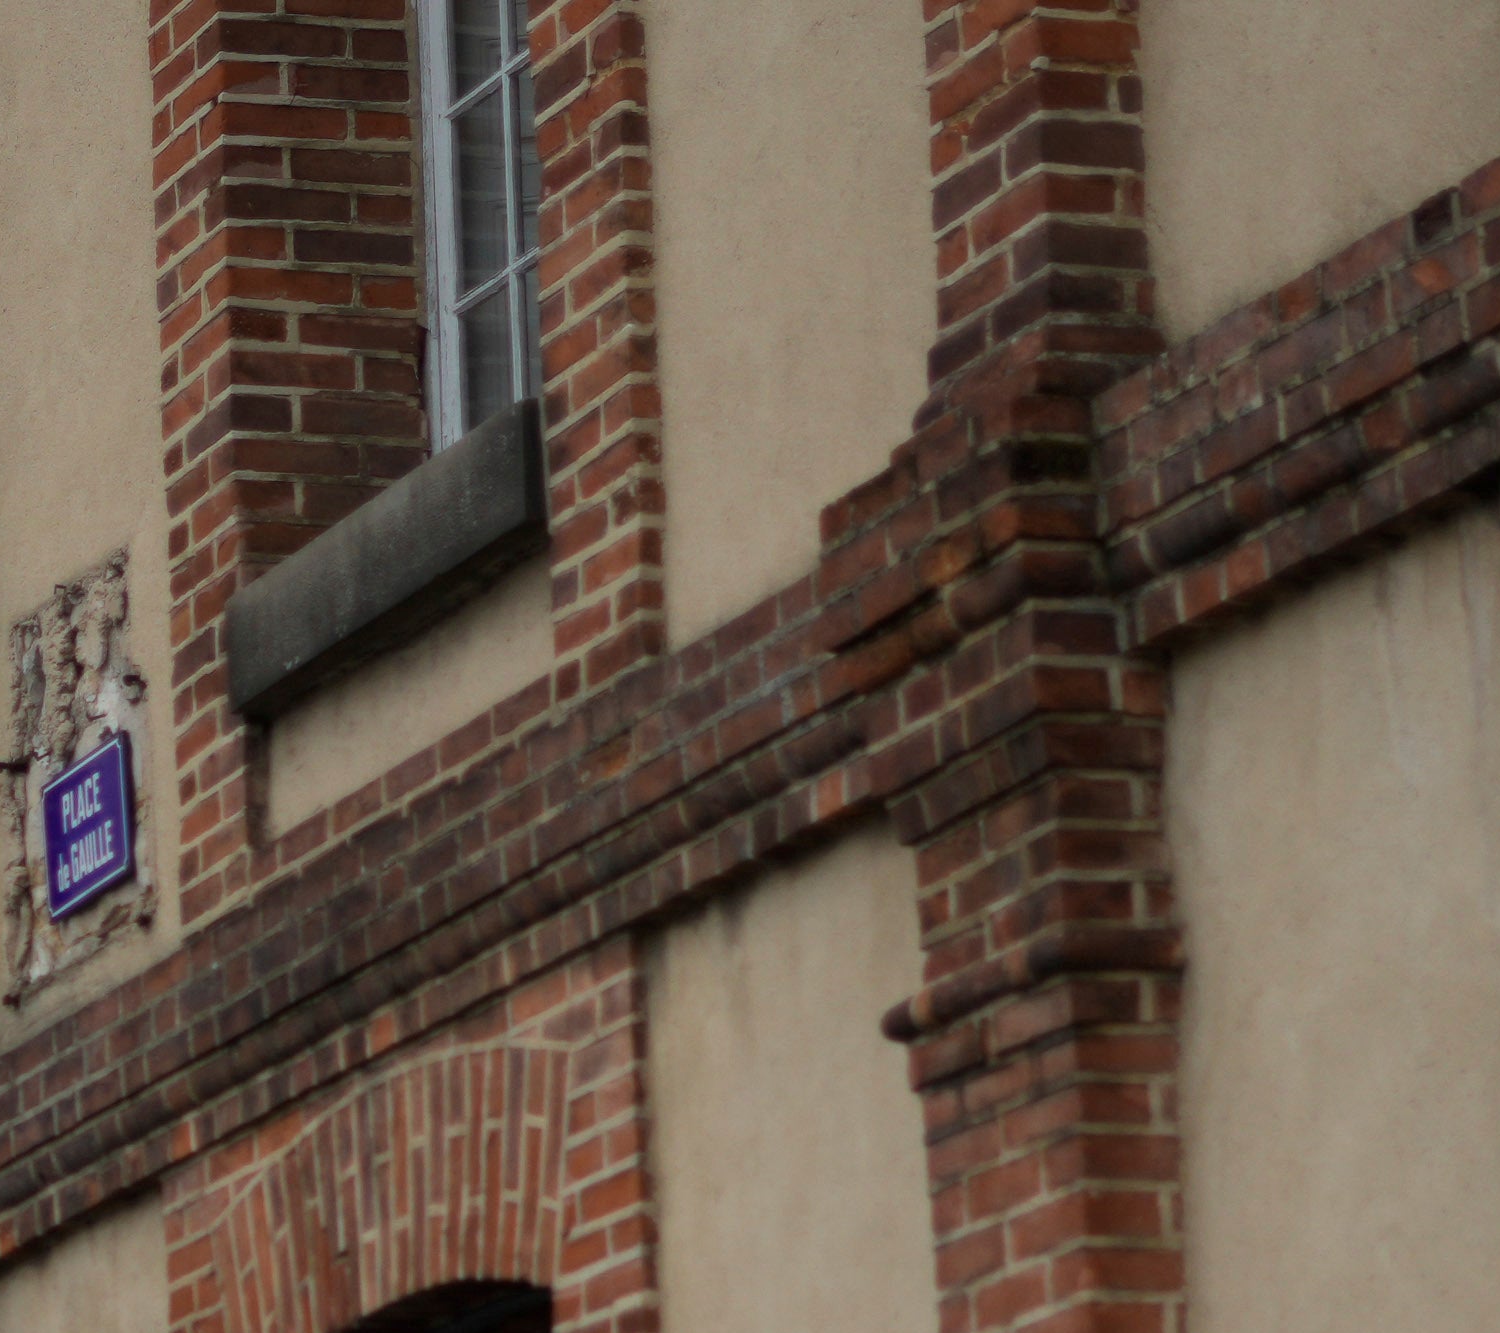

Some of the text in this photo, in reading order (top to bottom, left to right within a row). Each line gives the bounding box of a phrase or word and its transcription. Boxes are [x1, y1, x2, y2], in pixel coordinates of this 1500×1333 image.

[61, 771, 102, 834] PLACE
[57, 820, 114, 894] de GAULLE
